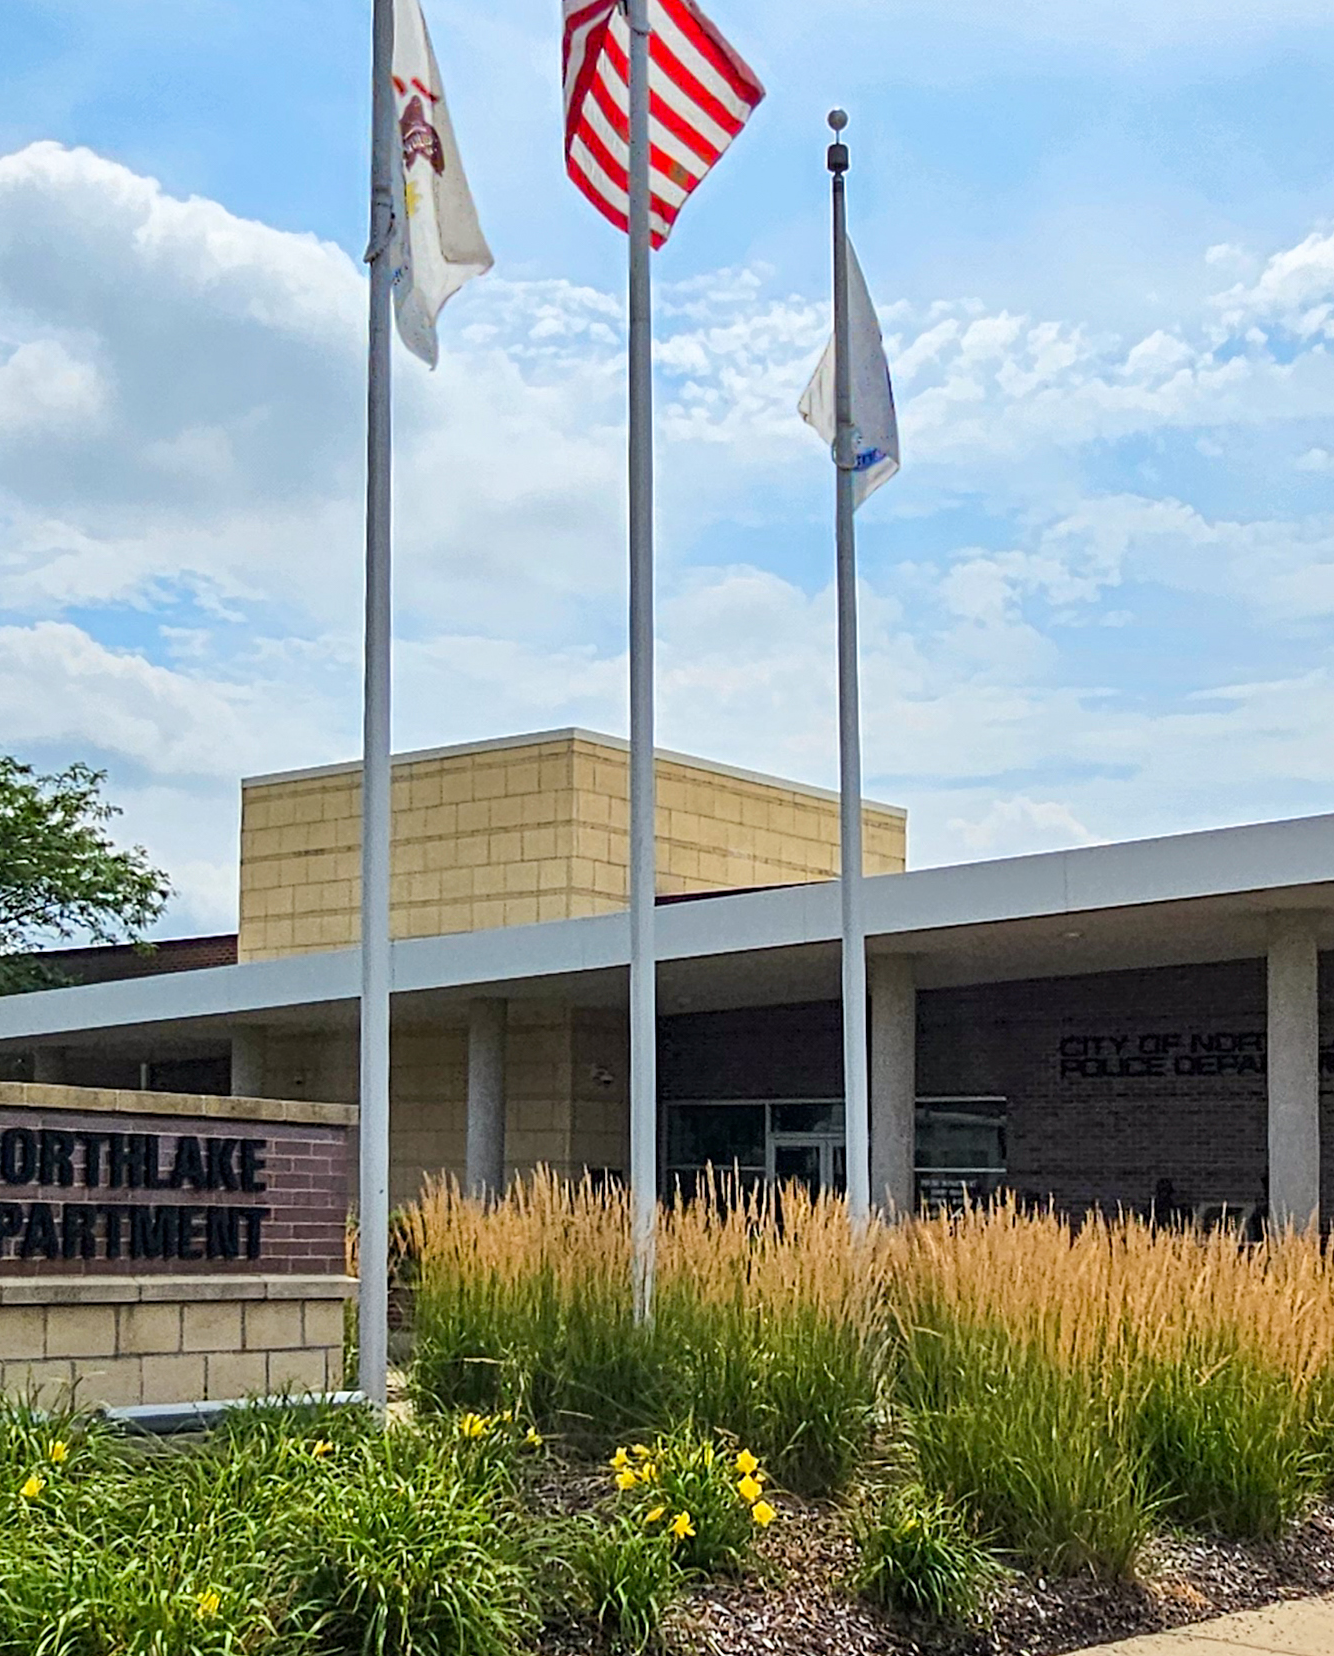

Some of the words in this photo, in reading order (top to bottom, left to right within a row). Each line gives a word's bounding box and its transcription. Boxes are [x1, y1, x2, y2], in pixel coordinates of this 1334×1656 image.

[1060, 1033, 1129, 1057] CITY
[1138, 1032, 1181, 1055] OF
[1060, 1055, 1166, 1079] POLICE
